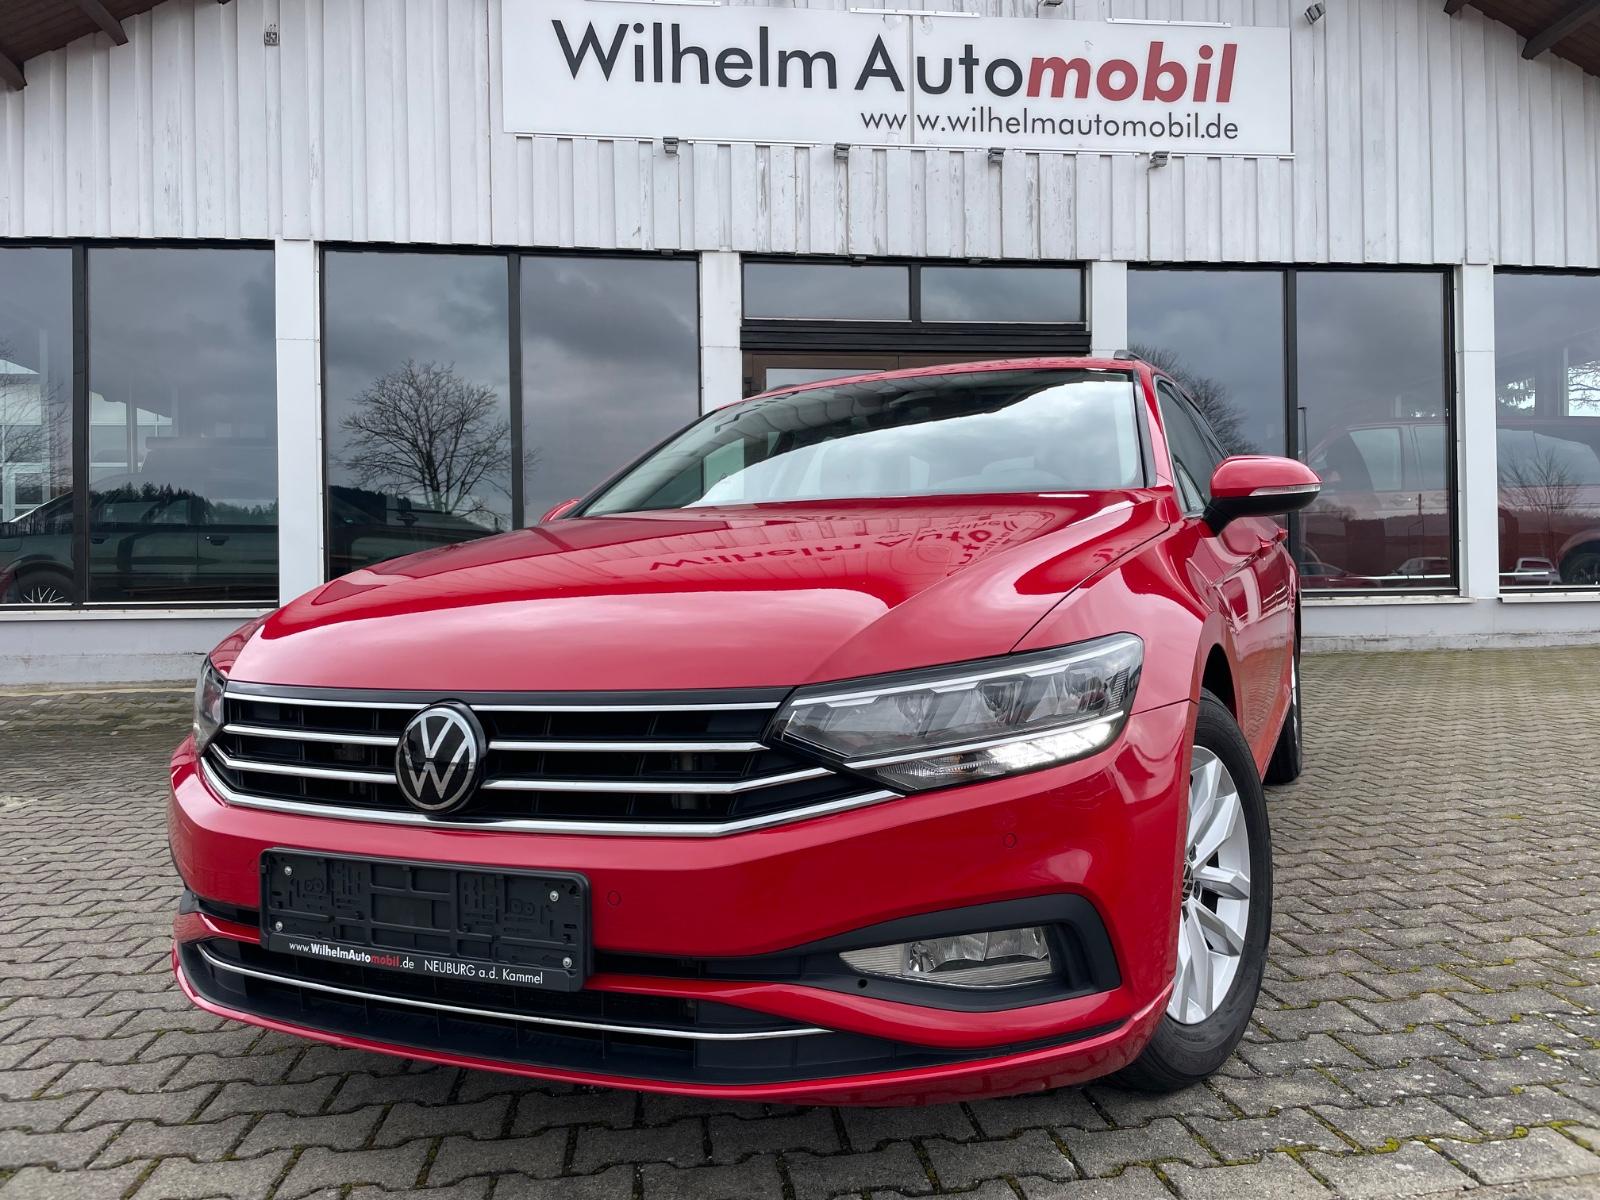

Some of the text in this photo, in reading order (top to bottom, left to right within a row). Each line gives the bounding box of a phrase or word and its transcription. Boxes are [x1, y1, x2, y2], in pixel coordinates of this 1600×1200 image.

[551, 19, 1238, 104] Wilhelm Automobil
[860, 106, 1239, 140] www.wilhelmautomobil.de
[288, 942, 543, 985] www.WilhelmAutomobil.de NEUBURG a.d. Kammel
